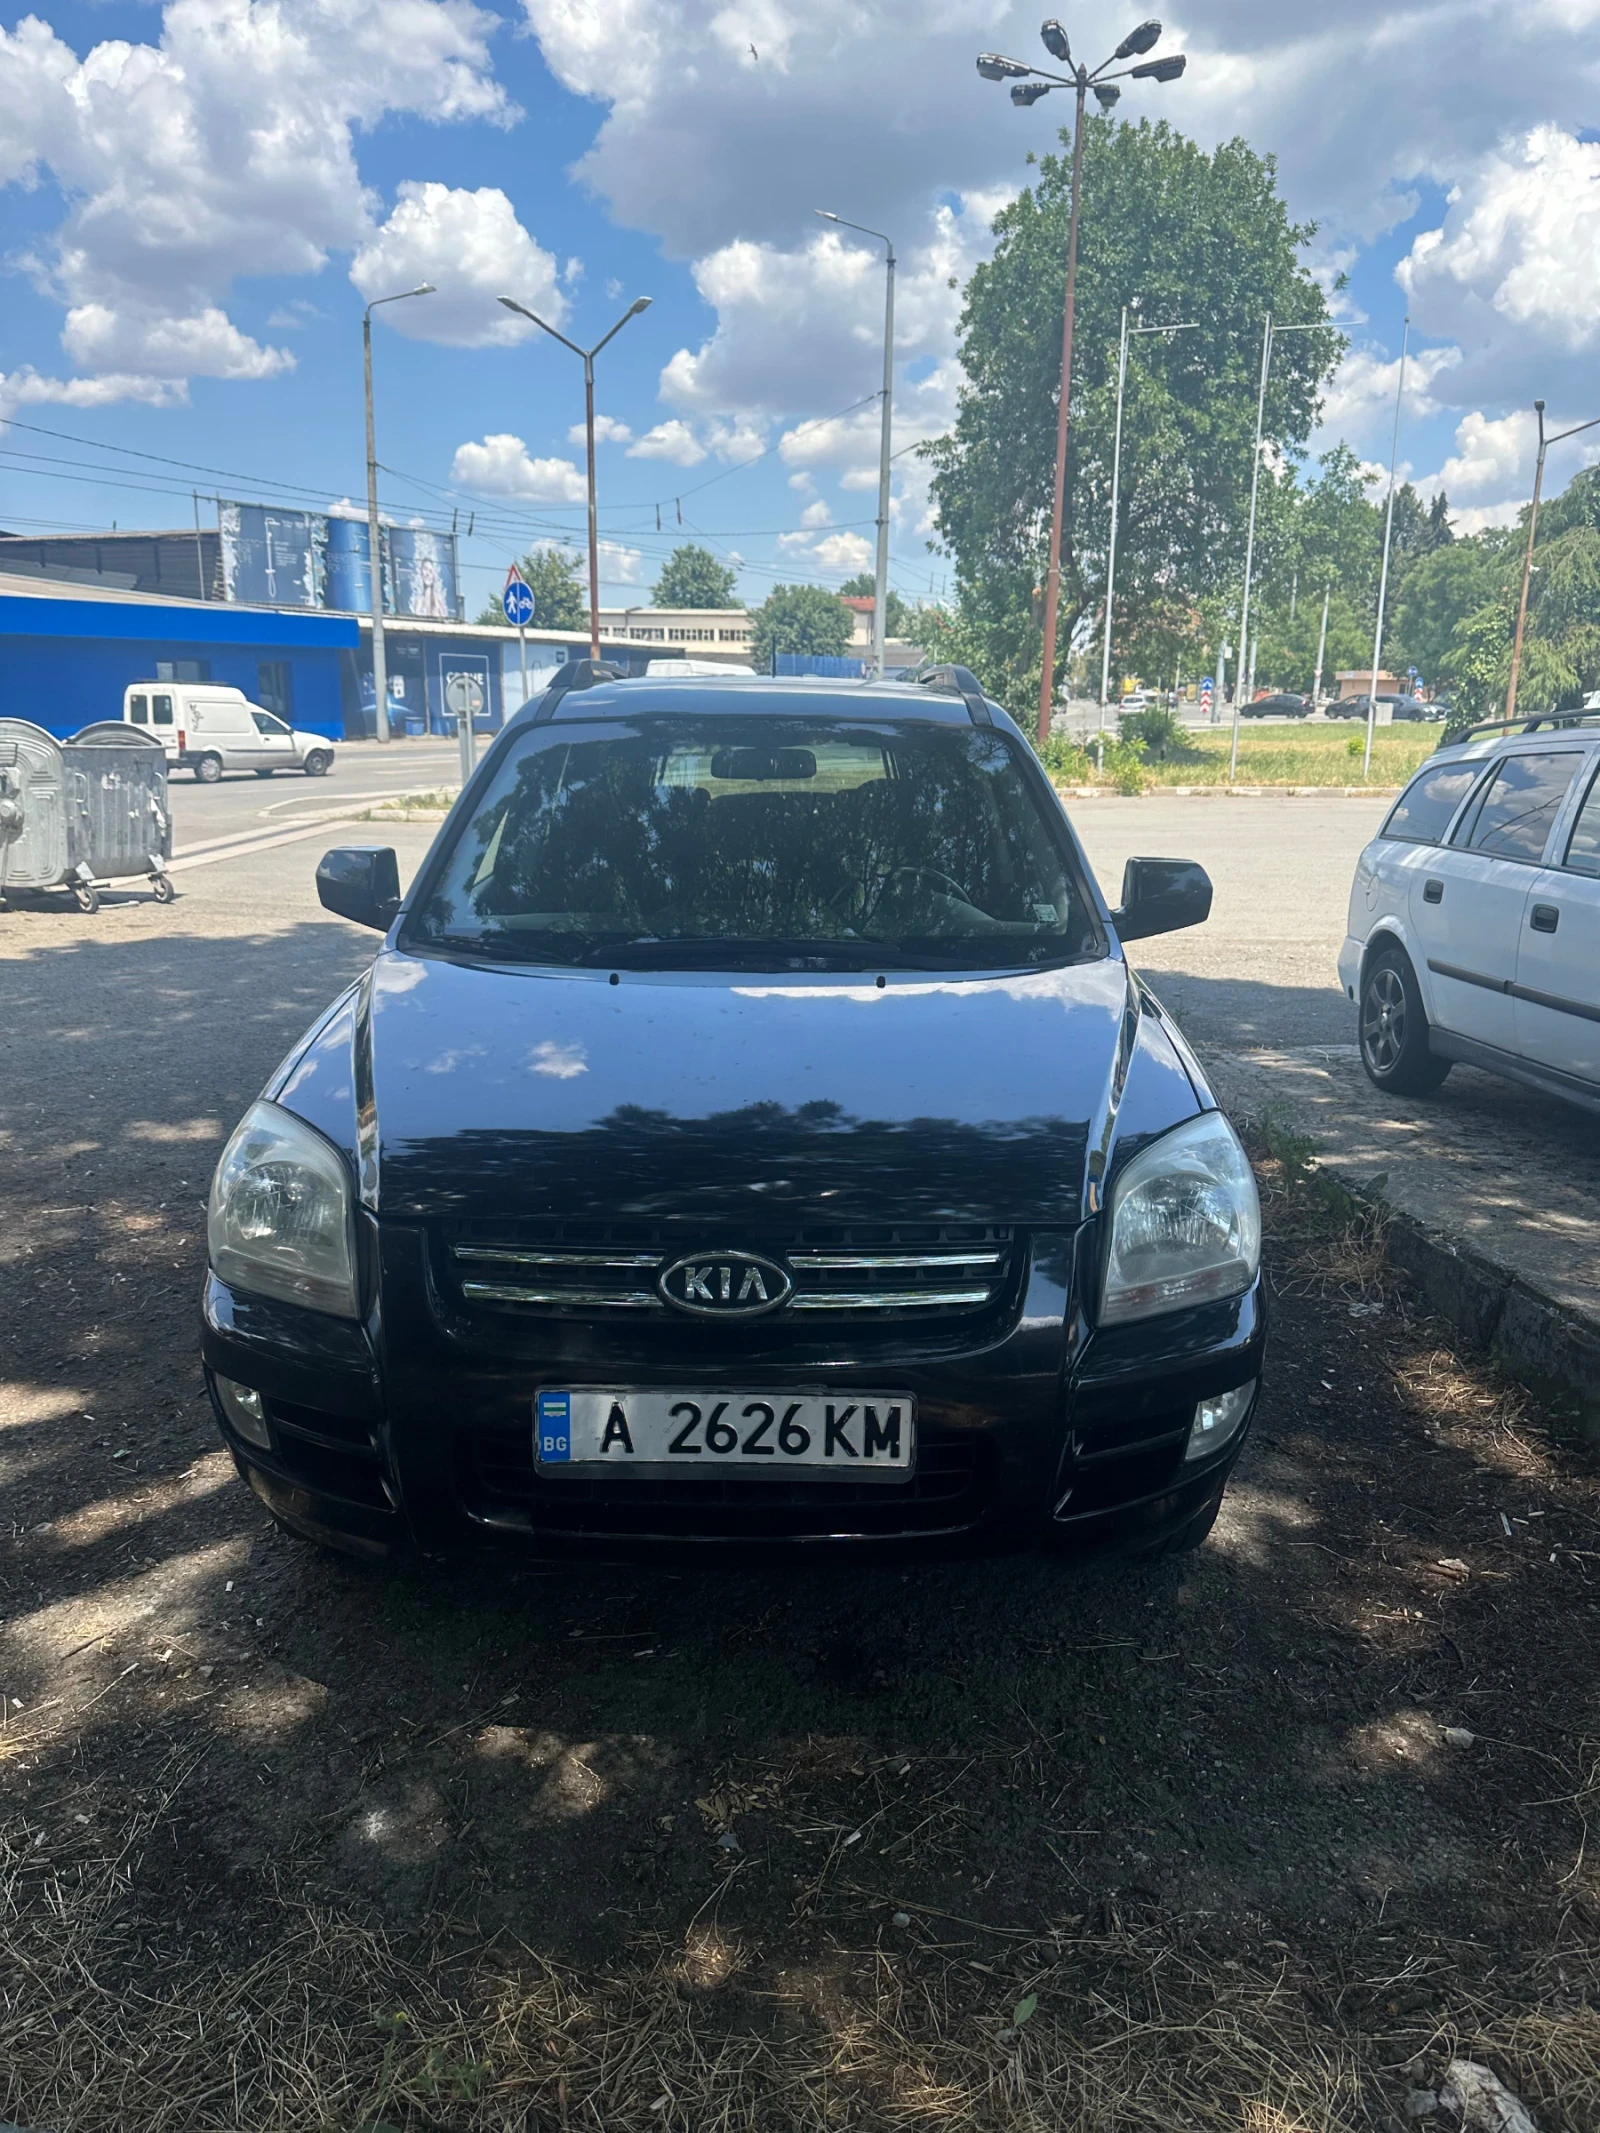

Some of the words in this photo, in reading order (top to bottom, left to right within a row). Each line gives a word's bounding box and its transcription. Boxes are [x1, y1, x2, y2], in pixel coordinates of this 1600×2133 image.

[684, 1267, 768, 1300] KIA
[543, 1436, 567, 1452] BG
[600, 1401, 634, 1453] A
[668, 1401, 811, 1455] 2626
[825, 1404, 901, 1459] KM
